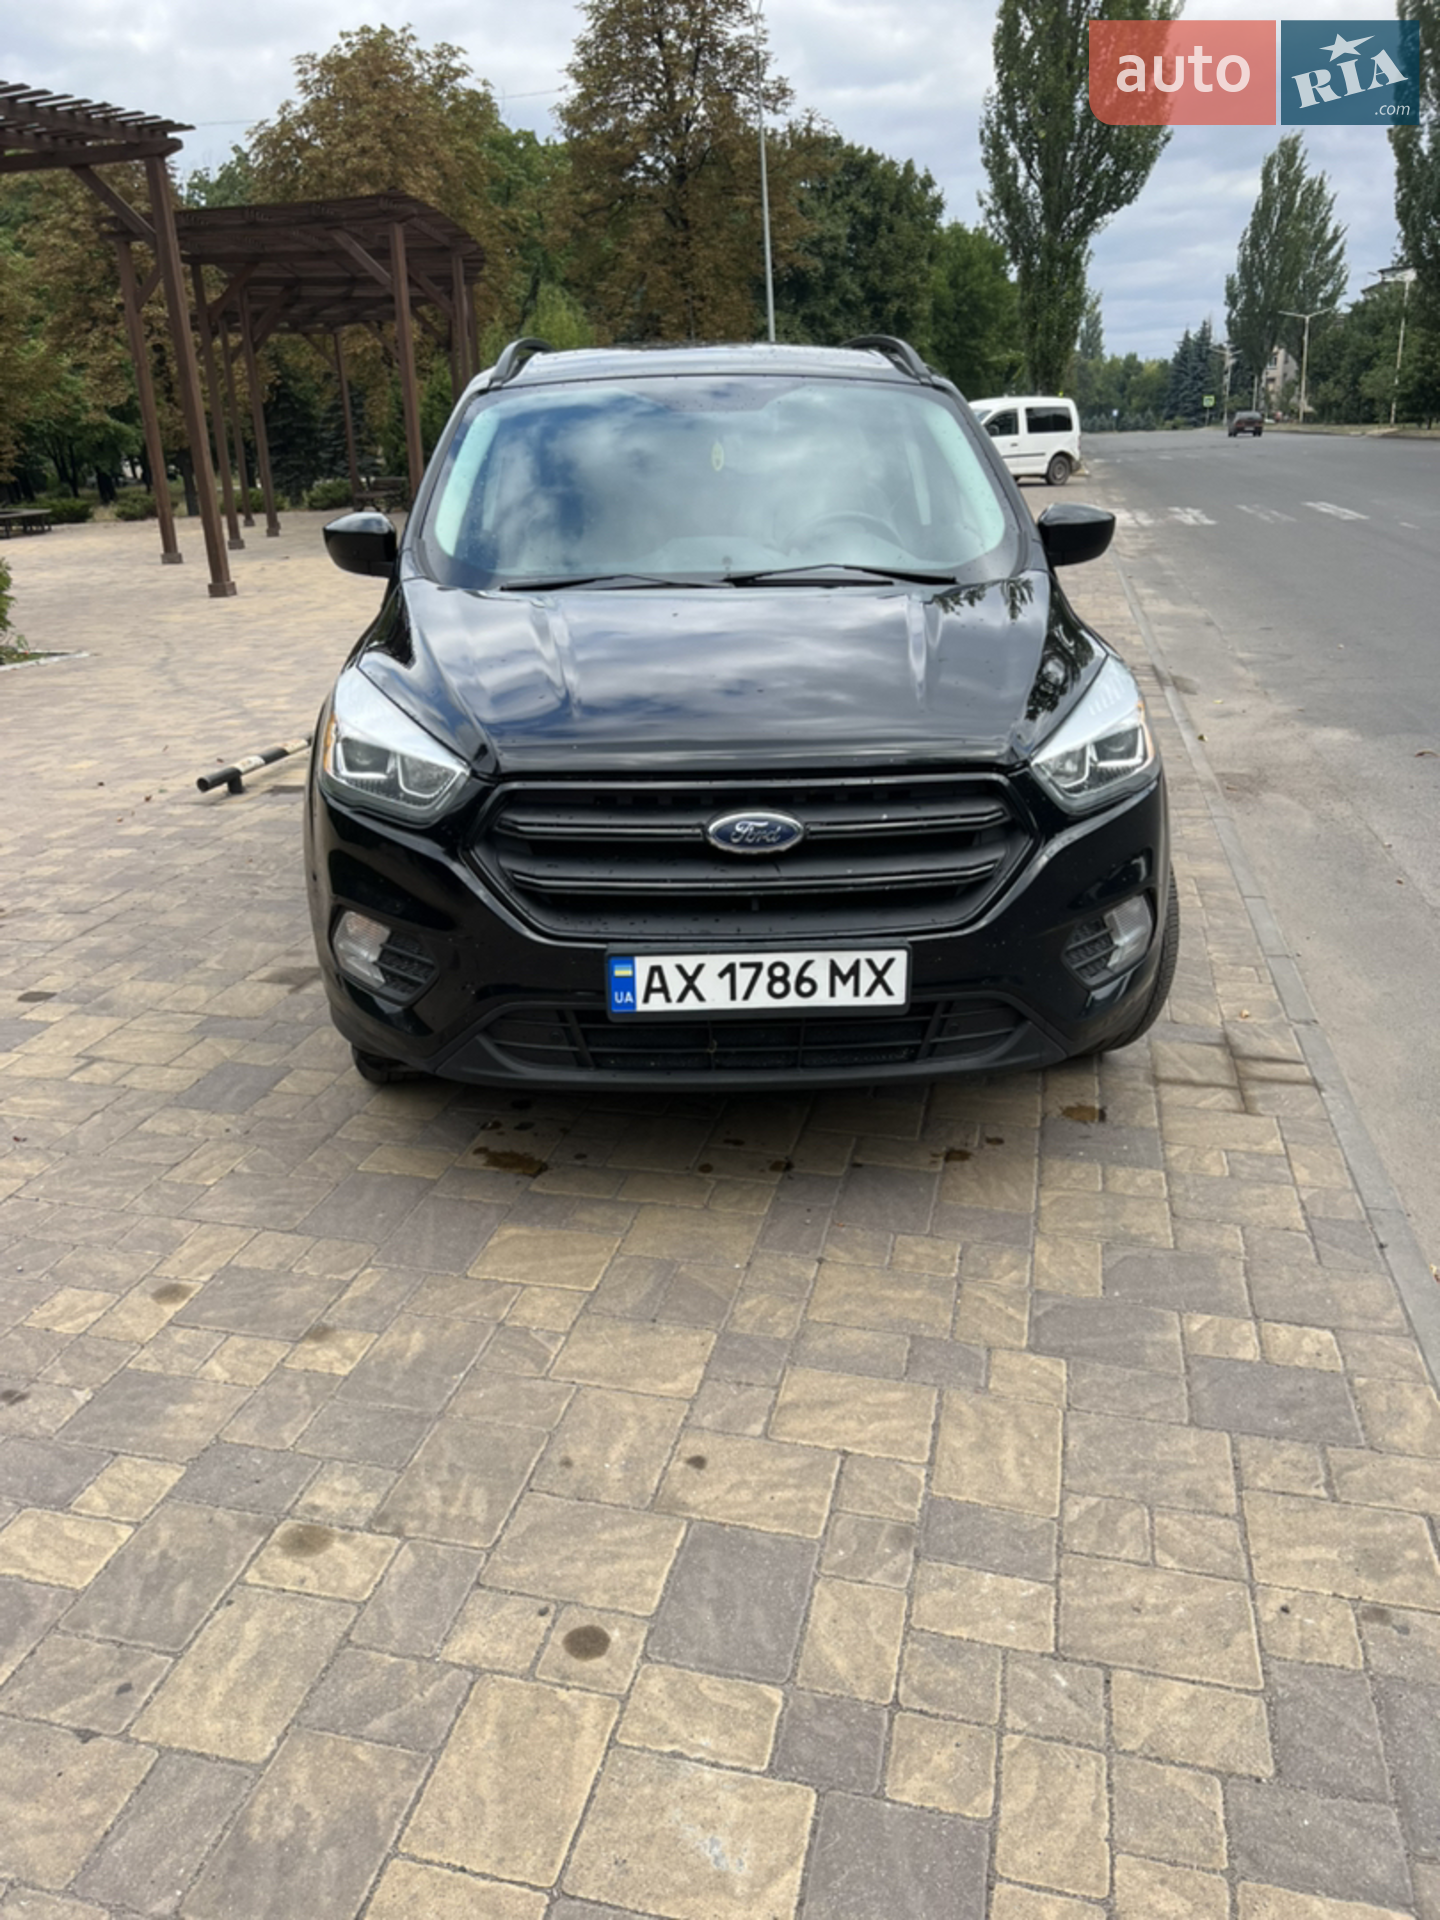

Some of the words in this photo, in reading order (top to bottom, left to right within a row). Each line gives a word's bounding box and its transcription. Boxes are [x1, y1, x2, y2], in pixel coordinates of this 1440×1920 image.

[731, 821, 781, 843] Ford
[642, 963, 707, 1003] AX
[717, 959, 818, 1001] 1786
[829, 957, 896, 998] MX
[614, 991, 634, 1004] UA
